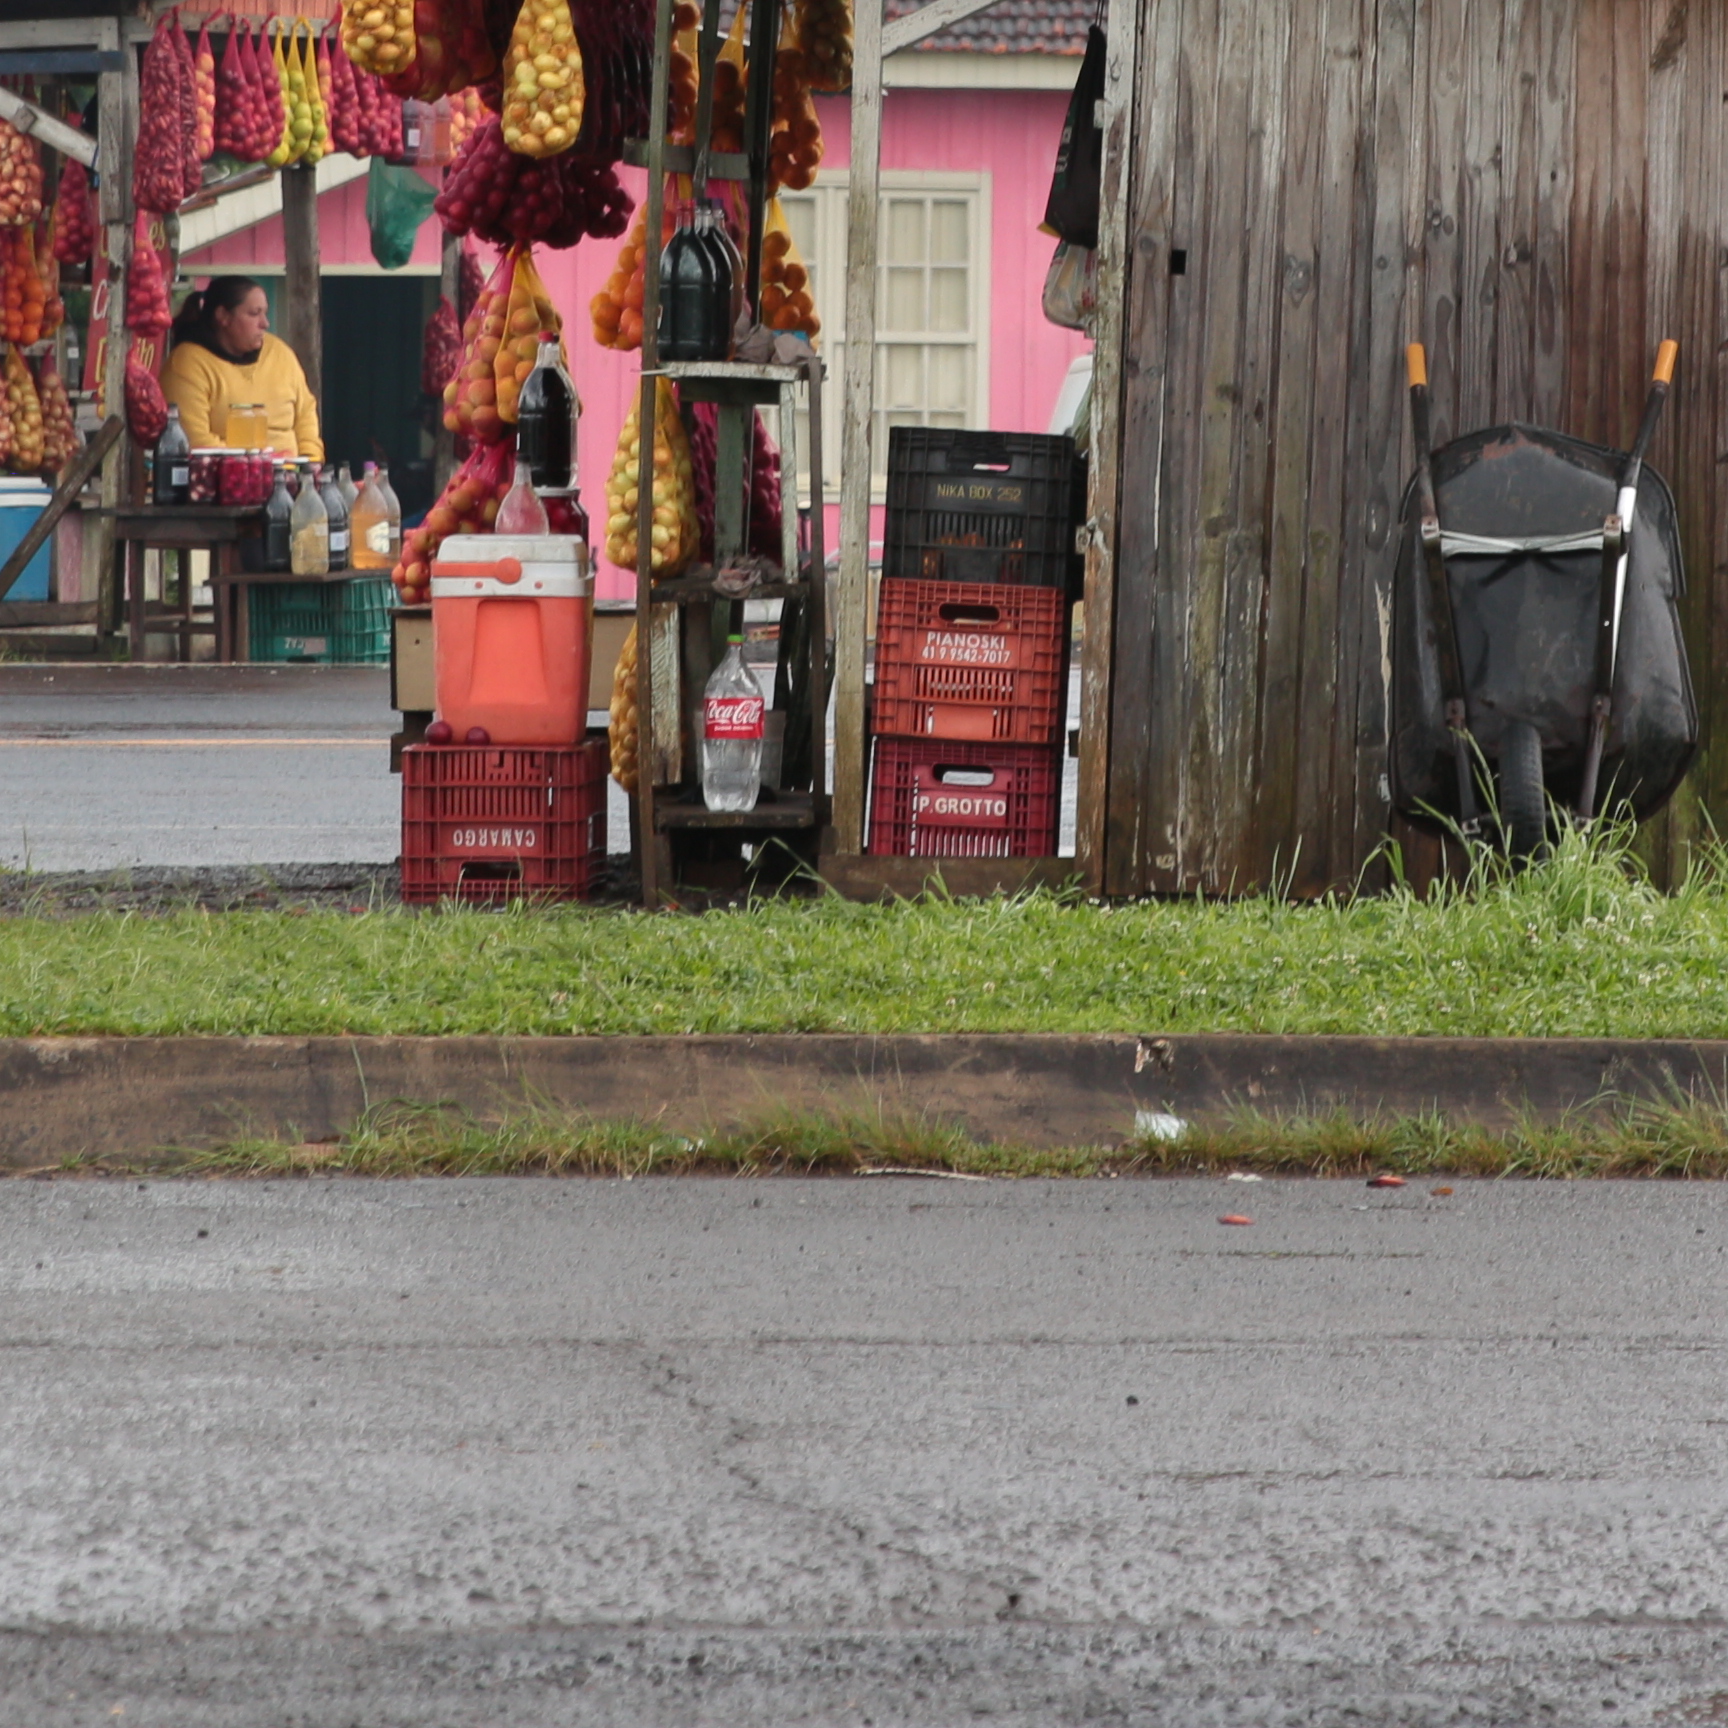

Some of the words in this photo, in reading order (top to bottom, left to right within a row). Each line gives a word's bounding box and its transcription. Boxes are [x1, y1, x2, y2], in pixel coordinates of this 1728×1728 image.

[969, 485, 992, 500] BOX
[997, 487, 1022, 502] 252
[927, 631, 1005, 649] PIANOSKI
[922, 646, 935, 660] 41
[939, 646, 947, 660] 9
[950, 647, 1011, 664] 9542-7017
[706, 699, 763, 725] Coca-Cola
[919, 795, 1007, 817] P.GROTTO
[452, 828, 536, 848] CAMARGO
